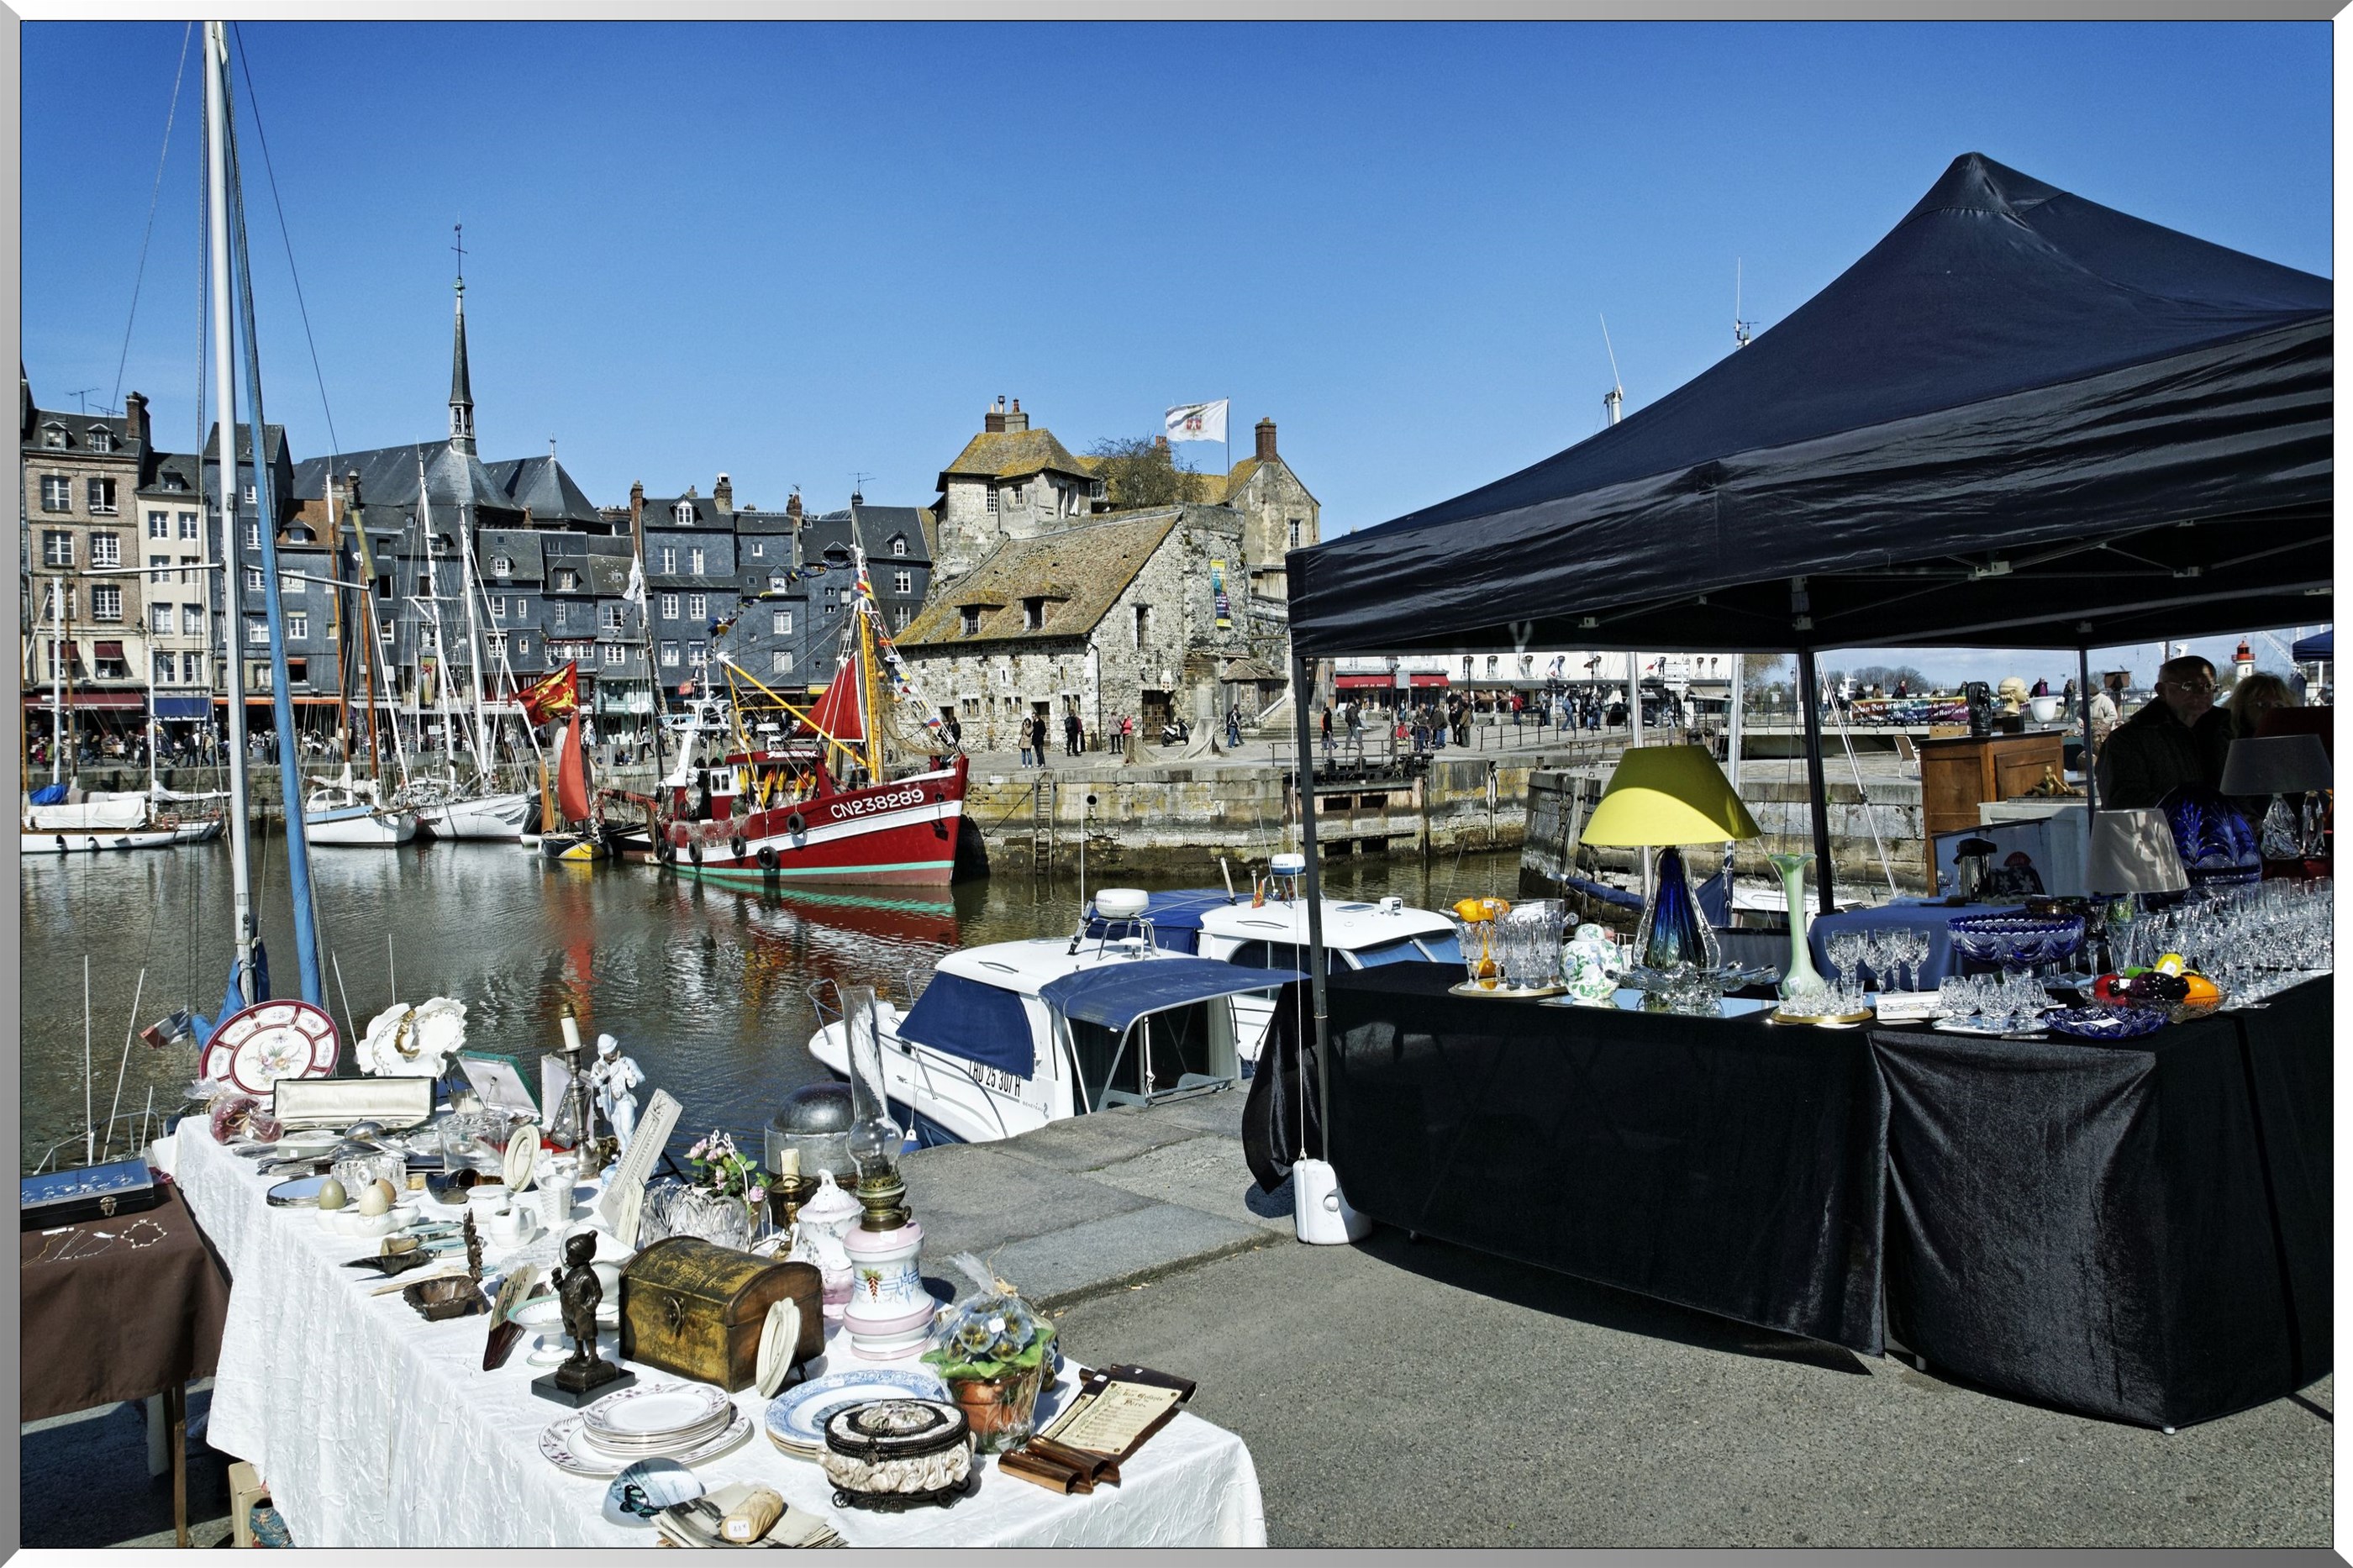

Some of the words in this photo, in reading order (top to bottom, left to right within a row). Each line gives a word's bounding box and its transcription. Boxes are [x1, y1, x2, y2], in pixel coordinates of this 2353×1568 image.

[831, 789, 925, 818] CN238289
[986, 1066, 997, 1088] 25
[999, 1071, 1013, 1094] 307
[1014, 1075, 1022, 1097] H
